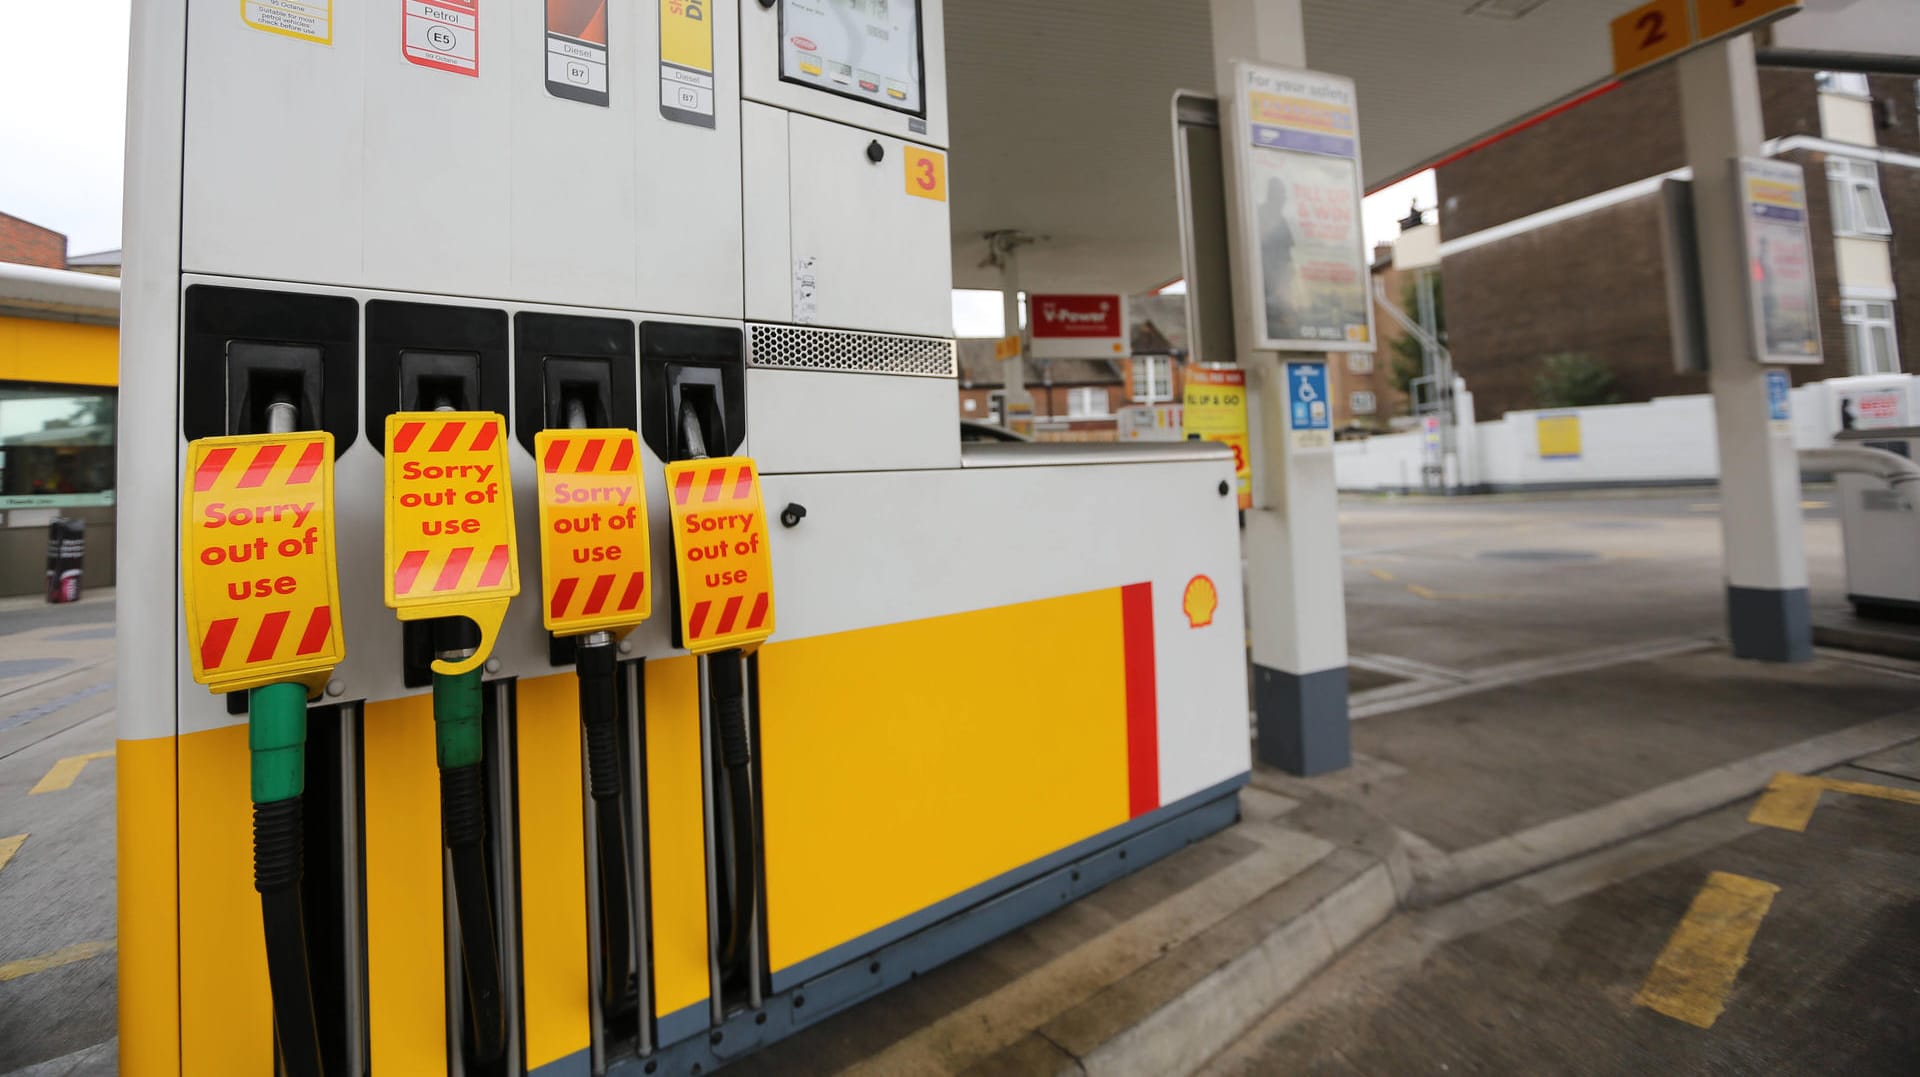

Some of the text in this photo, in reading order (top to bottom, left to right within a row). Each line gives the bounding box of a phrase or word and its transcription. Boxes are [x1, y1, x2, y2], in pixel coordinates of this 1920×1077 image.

[259, 6, 287, 18] Suitable
[298, 16, 315, 24] most
[281, 2, 305, 12] Octane
[424, 6, 459, 24] Petrol
[258, 18, 279, 26] check
[280, 23, 302, 32] before
[262, 13, 281, 22] petrol
[434, 32, 450, 44] E5
[1635, 10, 1667, 50] 2
[435, 55, 458, 64] Octane
[564, 44, 591, 58] Diesel
[572, 68, 584, 78] B7
[675, 71, 700, 83] Diesel
[1248, 71, 1349, 101] For your safety
[682, 93, 694, 102] B7
[916, 158, 936, 191] 3
[402, 461, 494, 483] Sorry
[400, 482, 498, 508] out of
[554, 483, 632, 506] Sorry
[203, 502, 316, 528] Sorry
[553, 506, 637, 534] out of
[685, 513, 754, 533] Sorry
[422, 518, 480, 536] use
[200, 527, 318, 565] out of
[573, 545, 621, 563] use
[687, 532, 759, 561] out of
[705, 569, 747, 588] use
[228, 576, 296, 600] use
